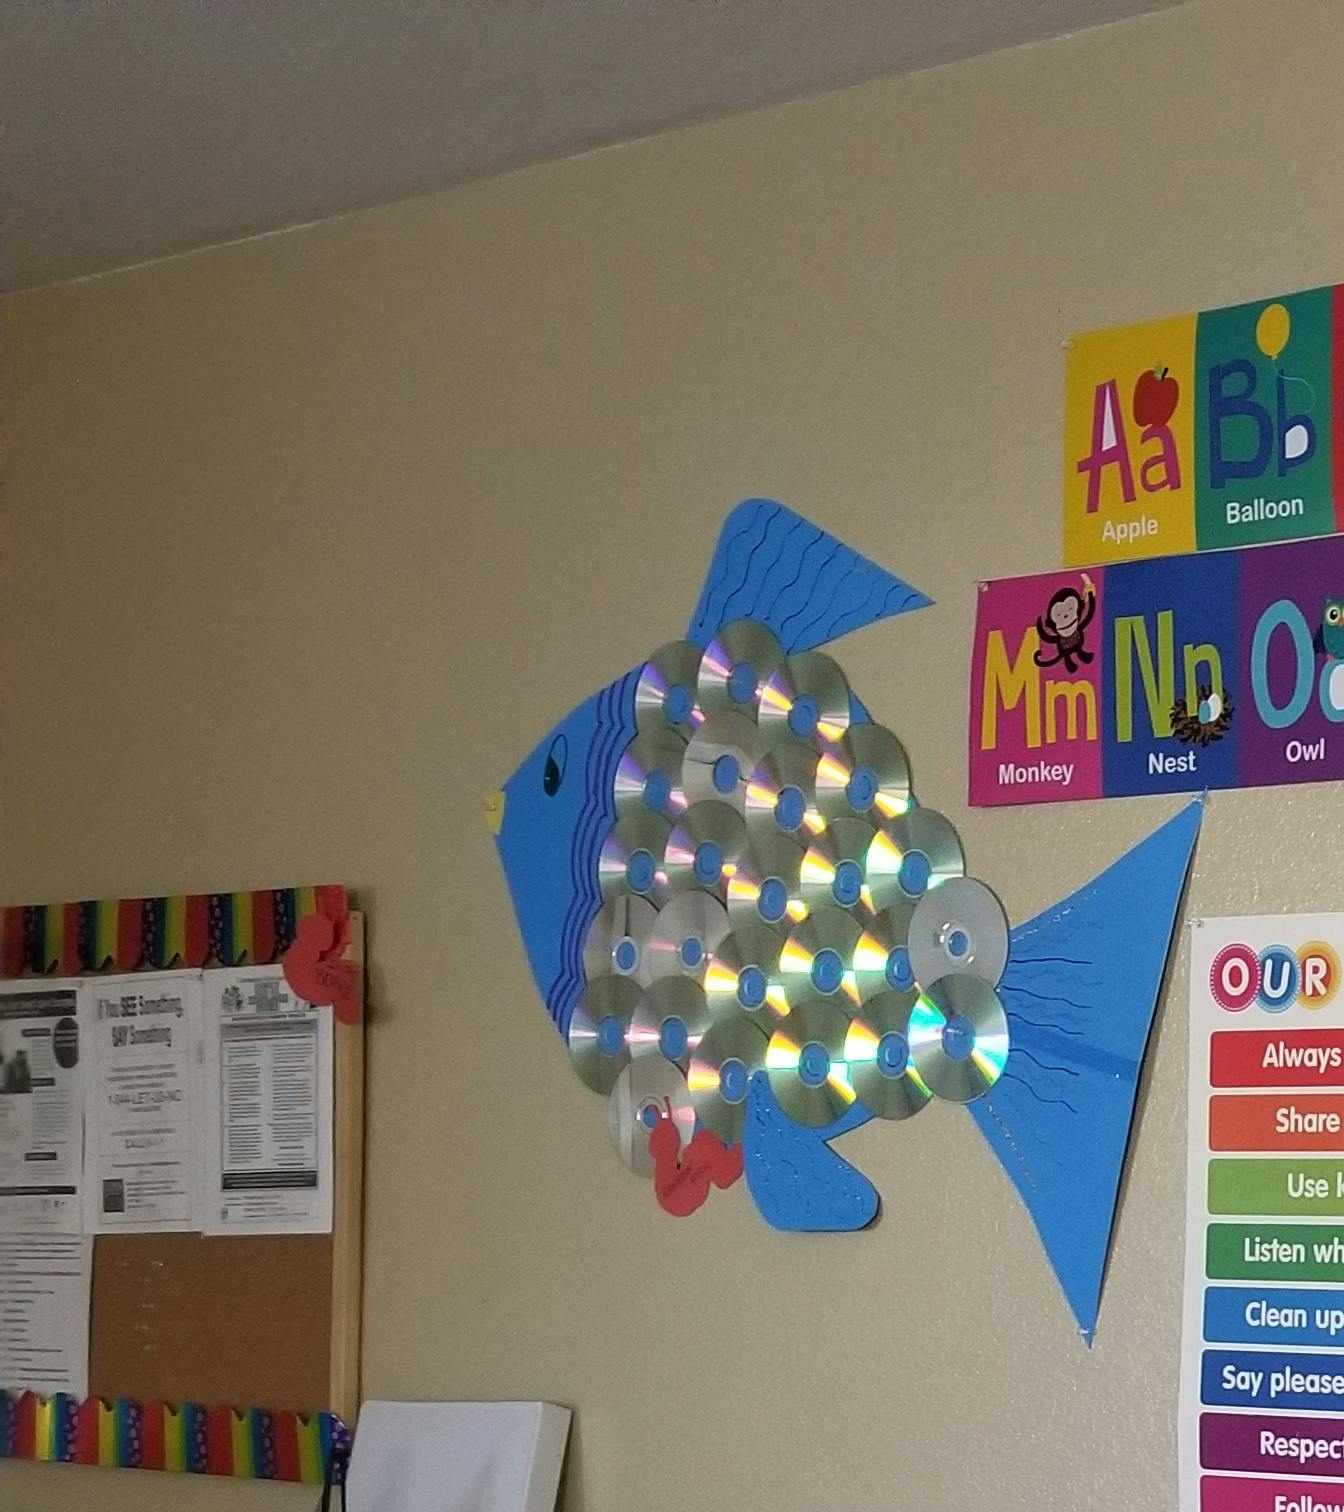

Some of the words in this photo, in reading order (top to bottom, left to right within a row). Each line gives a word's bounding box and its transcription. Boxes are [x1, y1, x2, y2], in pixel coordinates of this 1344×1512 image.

[1226, 496, 1304, 525] Balloon
[1102, 514, 1158, 543] Apple
[1148, 751, 1197, 774] Nest
[1285, 739, 1325, 764] Owl
[999, 761, 1074, 788] Monkey
[1221, 956, 1327, 1000] OUR
[1262, 1042, 1341, 1073] Always
[1276, 1107, 1340, 1132] Share
[1287, 1173, 1328, 1198] Use
[1245, 1238, 1304, 1263] Listen
[1245, 1302, 1306, 1328] Clean
[1316, 1310, 1344, 1335] up
[1222, 1365, 1262, 1395] Say
